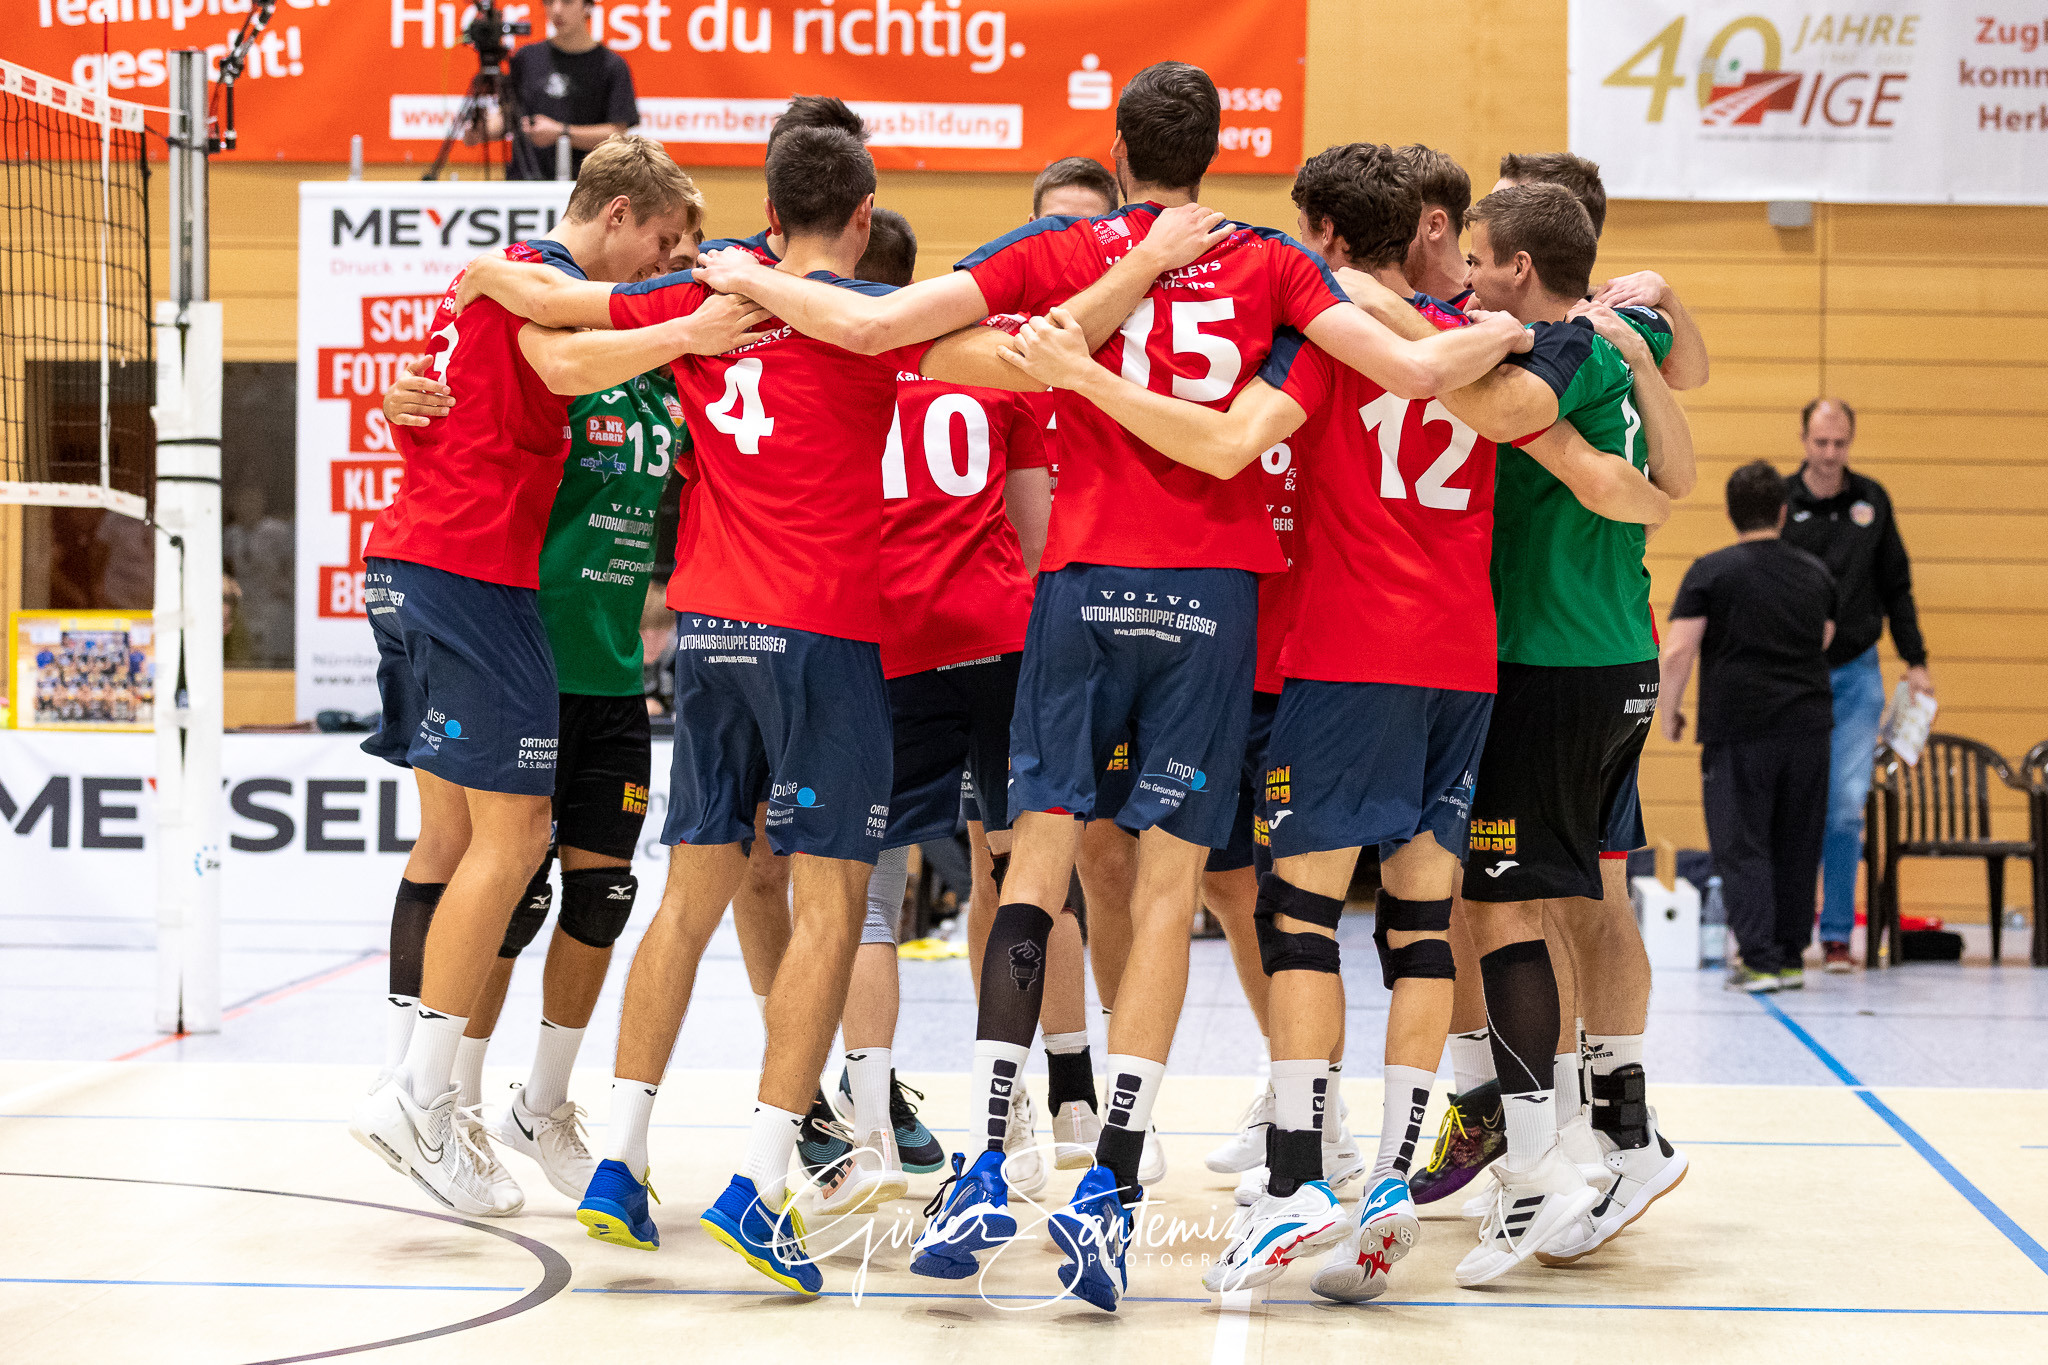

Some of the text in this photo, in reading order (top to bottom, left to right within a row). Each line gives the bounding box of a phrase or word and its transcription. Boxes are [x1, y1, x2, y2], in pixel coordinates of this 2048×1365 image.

[687, 0, 773, 54] du
[793, 0, 1026, 74] richtig.
[1792, 13, 1921, 54] JAHRE
[1801, 72, 1909, 127] IGE
[1120, 296, 1242, 402] 15
[705, 357, 775, 455] 4
[589, 432, 624, 444] FABRIK
[626, 421, 672, 478] 13
[1358, 391, 1479, 511] 12
[611, 502, 656, 518] VOLV
[1080, 605, 1218, 637] AUTOHAUSGRUPPE GEISSER
[1100, 590, 1201, 609] VOLVO
[679, 634, 787, 654] AUTOHAUSGRUPPE GEISSER
[692, 618, 768, 630] VOLVO
[0, 775, 418, 853] MESEL
